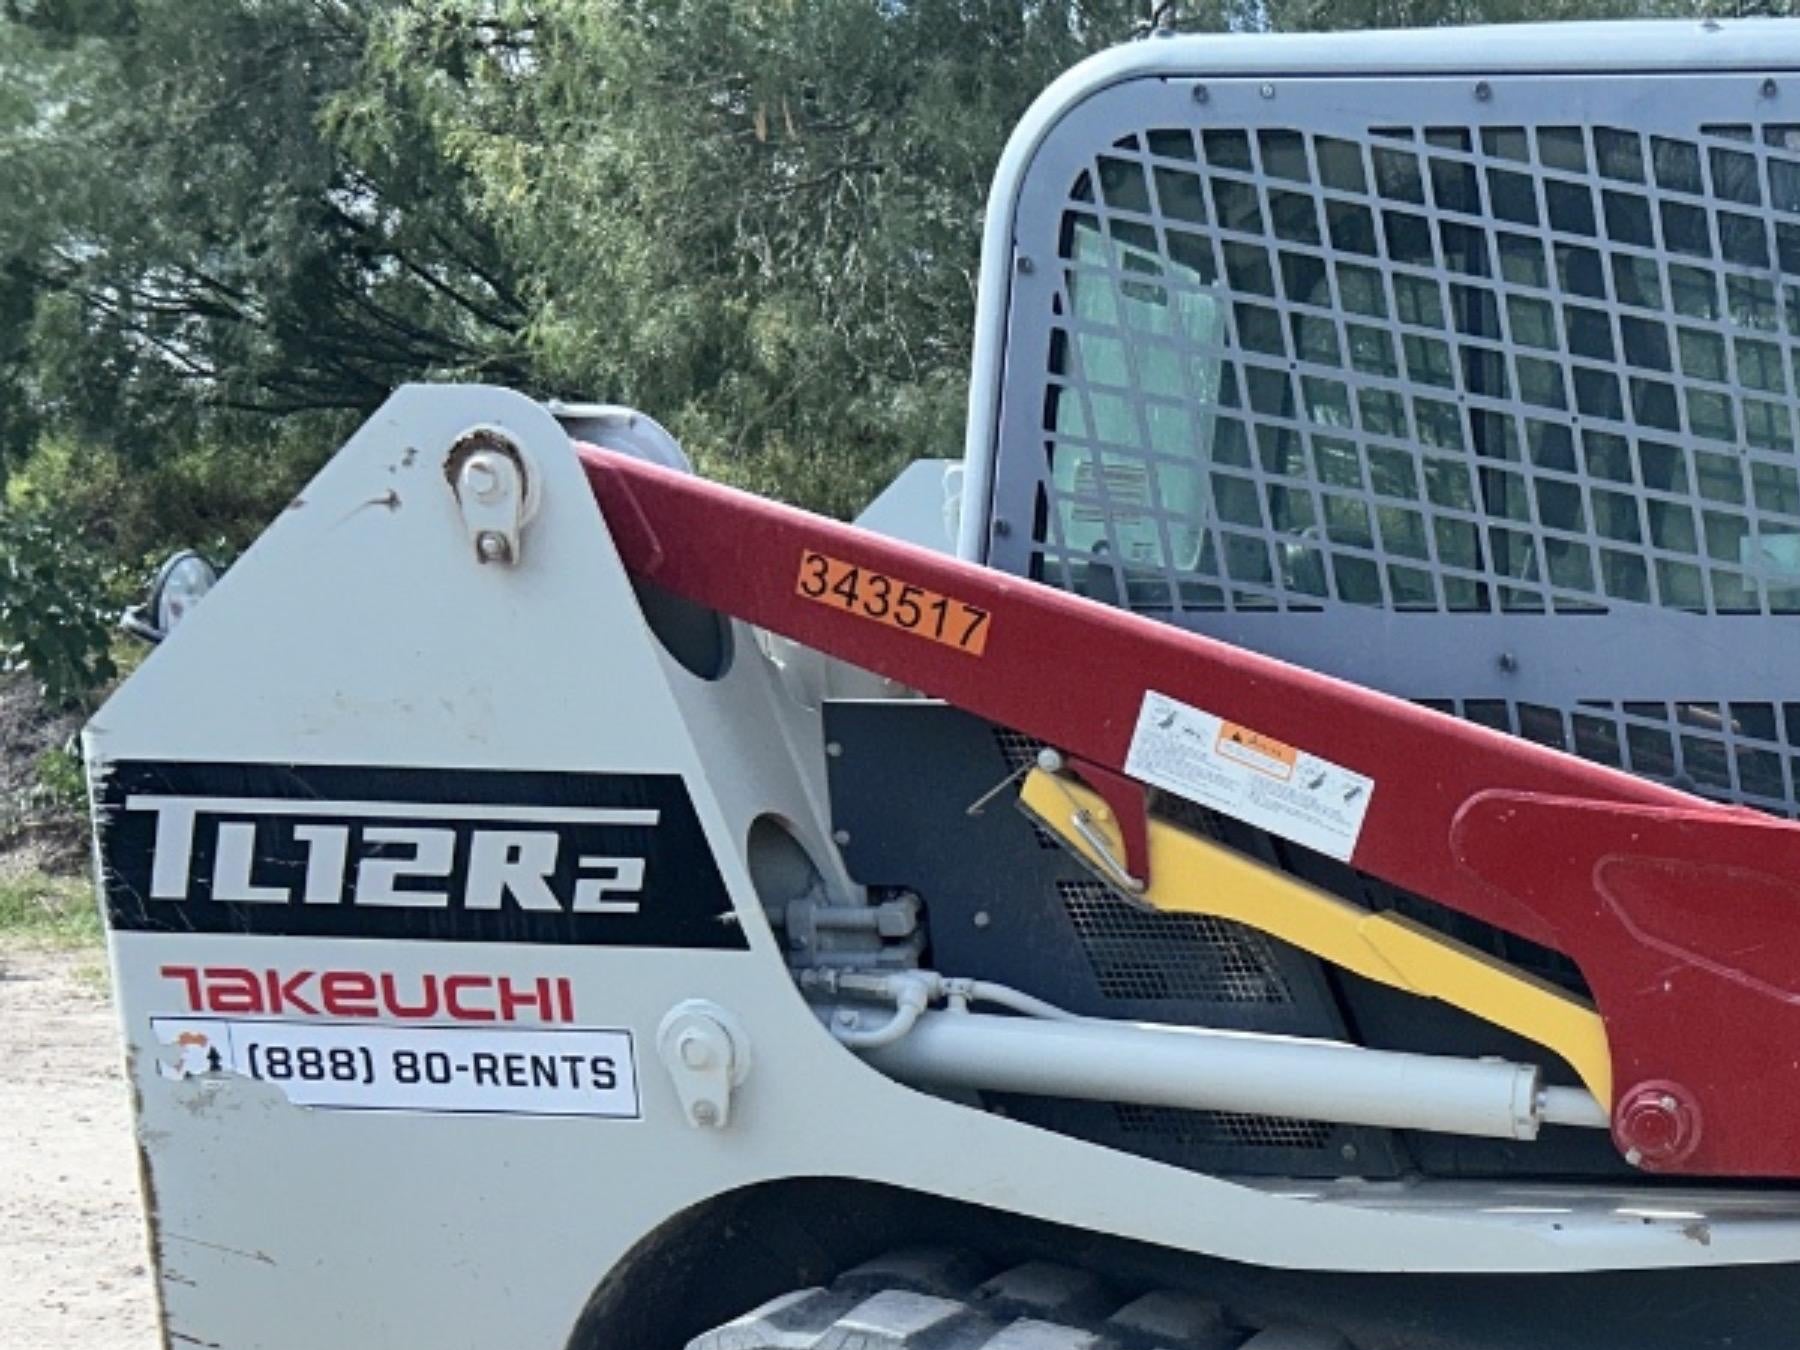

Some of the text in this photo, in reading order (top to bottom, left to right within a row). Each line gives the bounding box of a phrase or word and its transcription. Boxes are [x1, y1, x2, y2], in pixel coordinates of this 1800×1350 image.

[801, 554, 988, 648] 343517
[125, 794, 660, 913] TL12R2
[248, 1042, 617, 1090] (888) 80-RENTS
